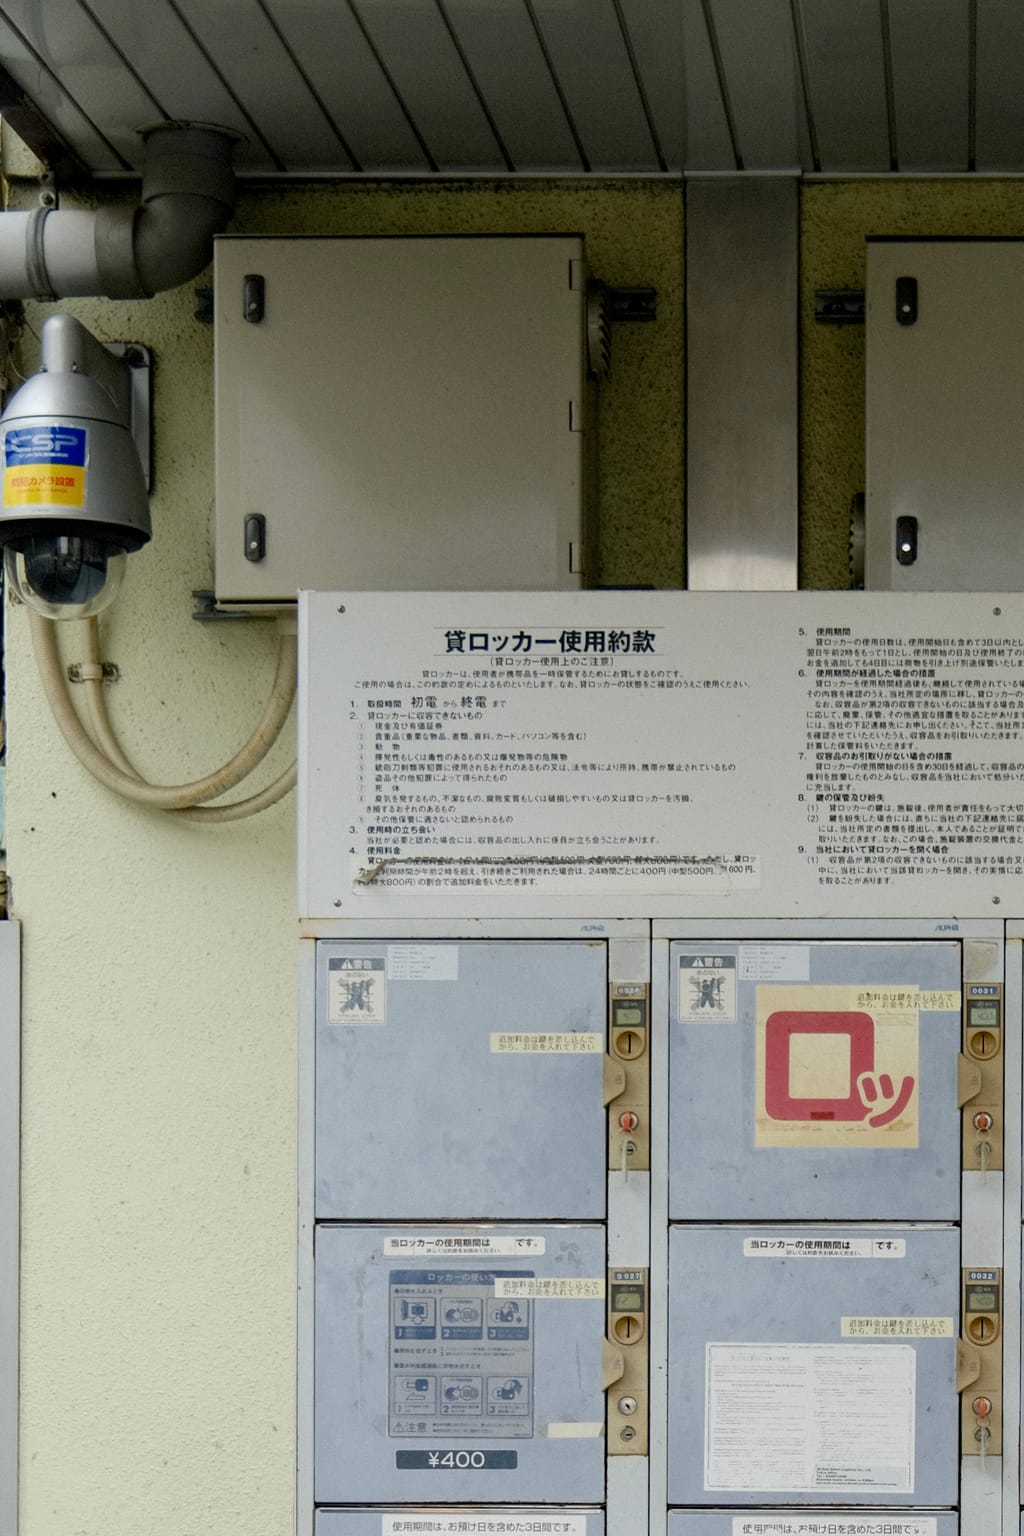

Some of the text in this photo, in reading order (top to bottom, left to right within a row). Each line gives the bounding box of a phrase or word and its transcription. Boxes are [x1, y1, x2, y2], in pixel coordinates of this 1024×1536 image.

[816, 628, 851, 636] 使用期間
[445, 630, 655, 653] 貸ロッカー使用約款
[816, 669, 935, 677] 使用期間が経過した場合の措置
[368, 700, 402, 708] 取扱時間
[411, 696, 438, 709] 初電
[461, 696, 488, 709] 終電
[367, 711, 483, 720] 貸ロッカーに収容できないもの
[816, 752, 952, 760] 収容品のお引取りがない場合の措置
[816, 794, 884, 802] 鍵の保管及び紛失
[367, 826, 435, 835] 使用時の立ち会い
[367, 847, 401, 855] 使用料金
[816, 846, 948, 854] 当社において貸ロッカーを開く場合
[704, 958, 723, 967] 警告
[765, 1011, 915, 1128] ロッ
[391, 1239, 539, 1247] 当ロッカーの使用期間は です。
[751, 1240, 899, 1249] 当ロッカーの使用期間は です。
[406, 1422, 427, 1433] 注意
[429, 1452, 485, 1467] ¥400
[392, 1521, 577, 1532] 使用期間は、お預け日を含めた3日間です。
